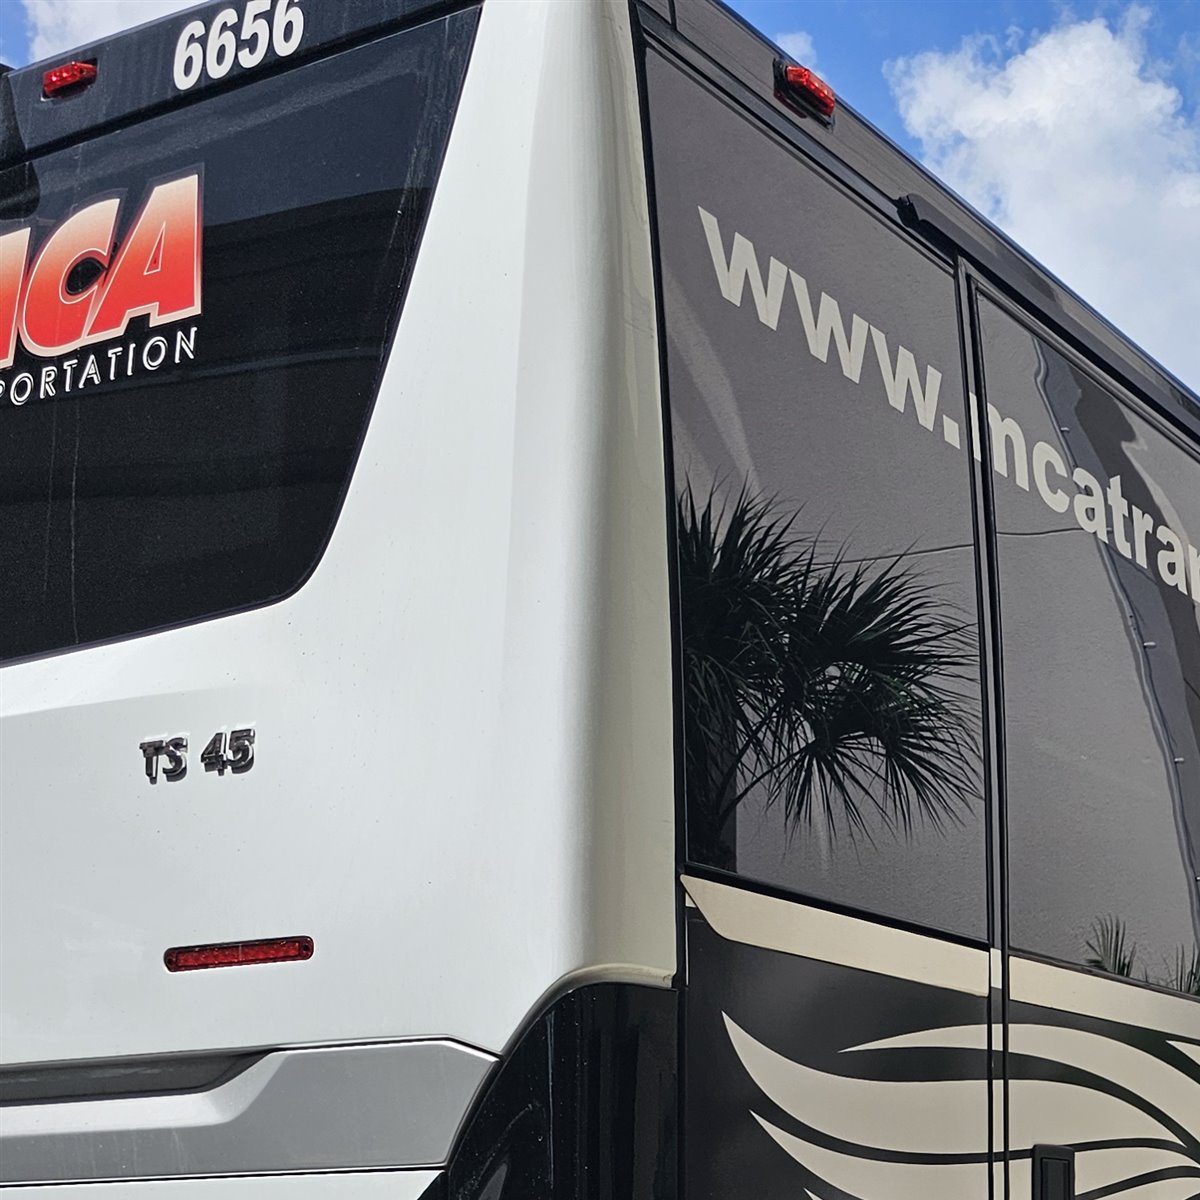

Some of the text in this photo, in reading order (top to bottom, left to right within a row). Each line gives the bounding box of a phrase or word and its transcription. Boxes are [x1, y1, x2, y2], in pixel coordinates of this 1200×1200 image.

[173, 0, 305, 90] 6656
[139, 728, 256, 785] TS 45
